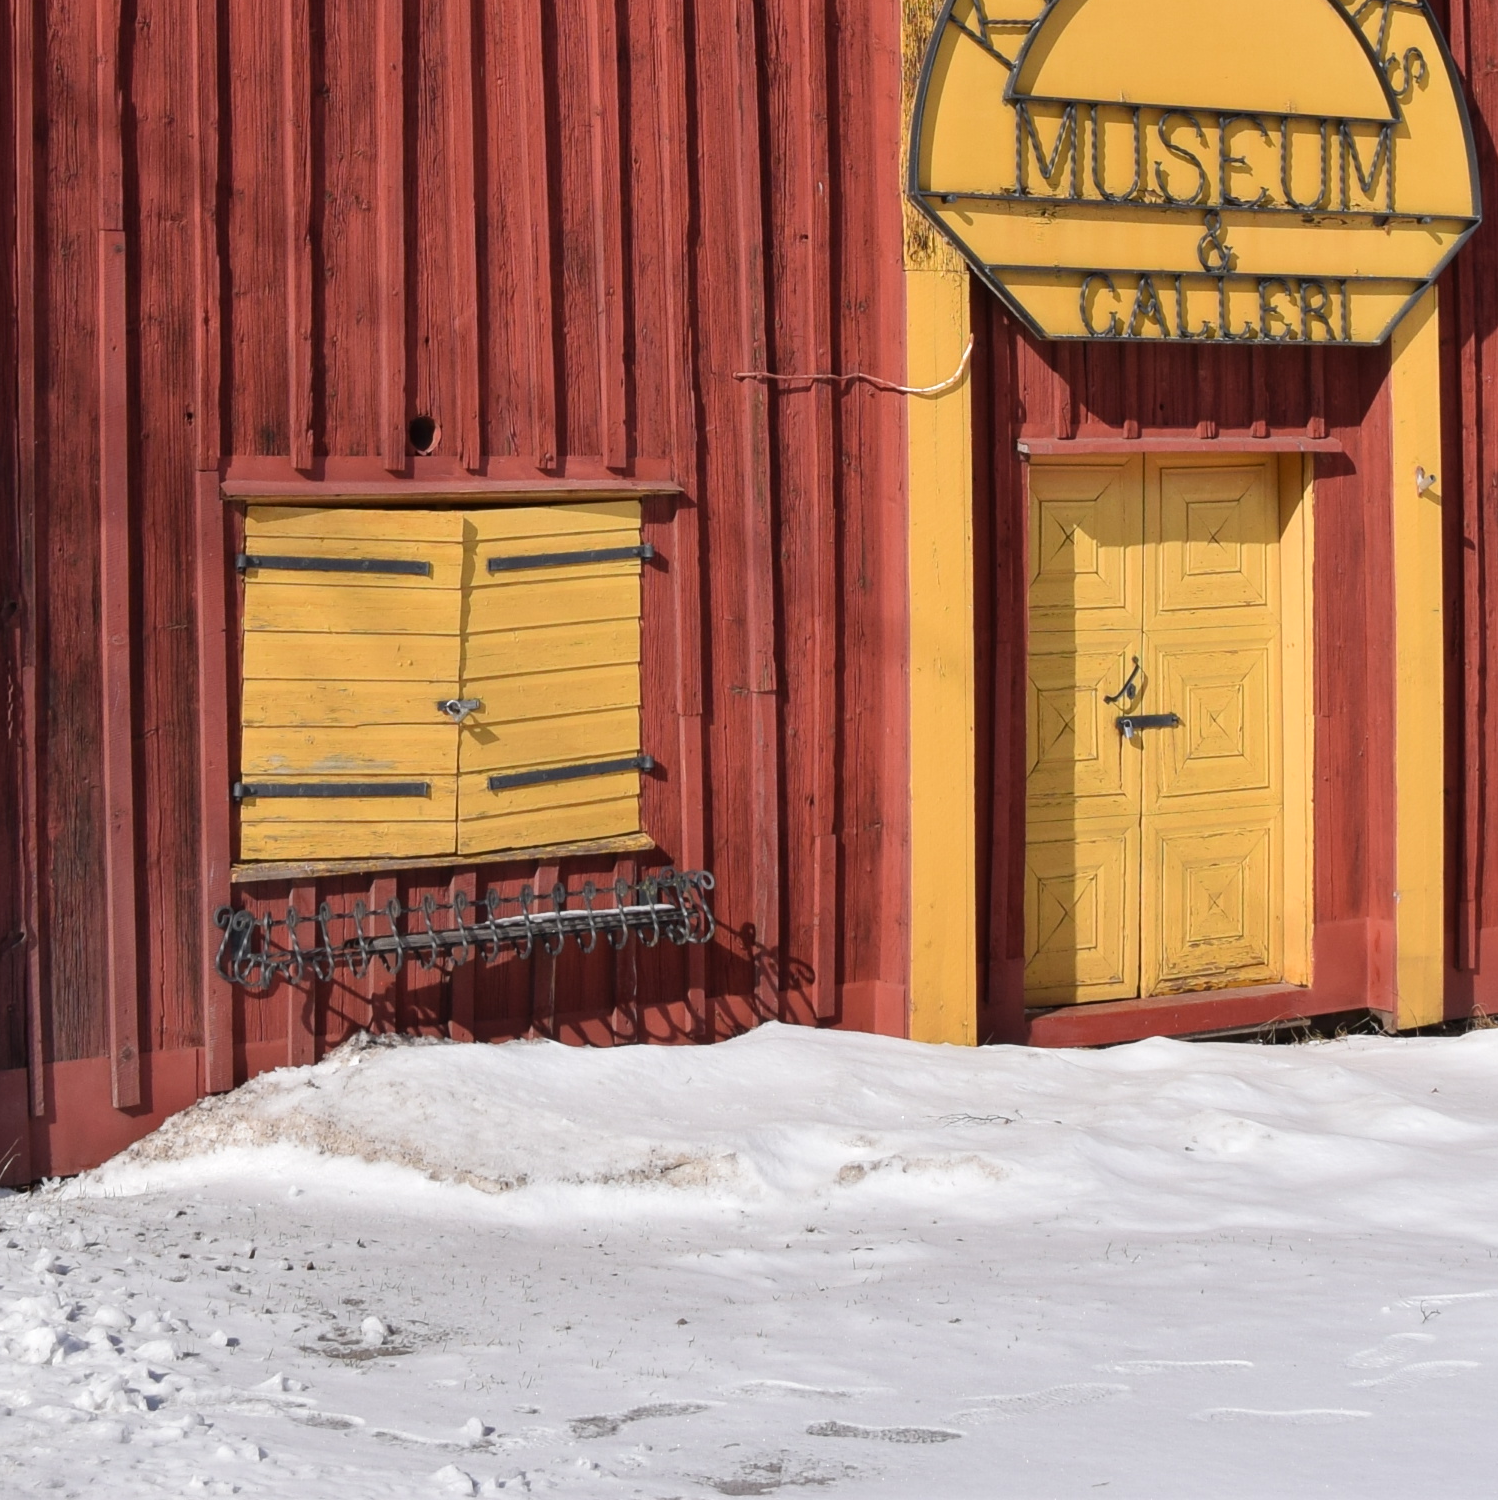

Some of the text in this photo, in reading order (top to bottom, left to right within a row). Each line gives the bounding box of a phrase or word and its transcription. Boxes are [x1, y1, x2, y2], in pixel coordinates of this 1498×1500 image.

[1015, 103, 1394, 212] MUSEUM
[1198, 211, 1232, 272] &
[1080, 274, 1350, 340] GALLERI
